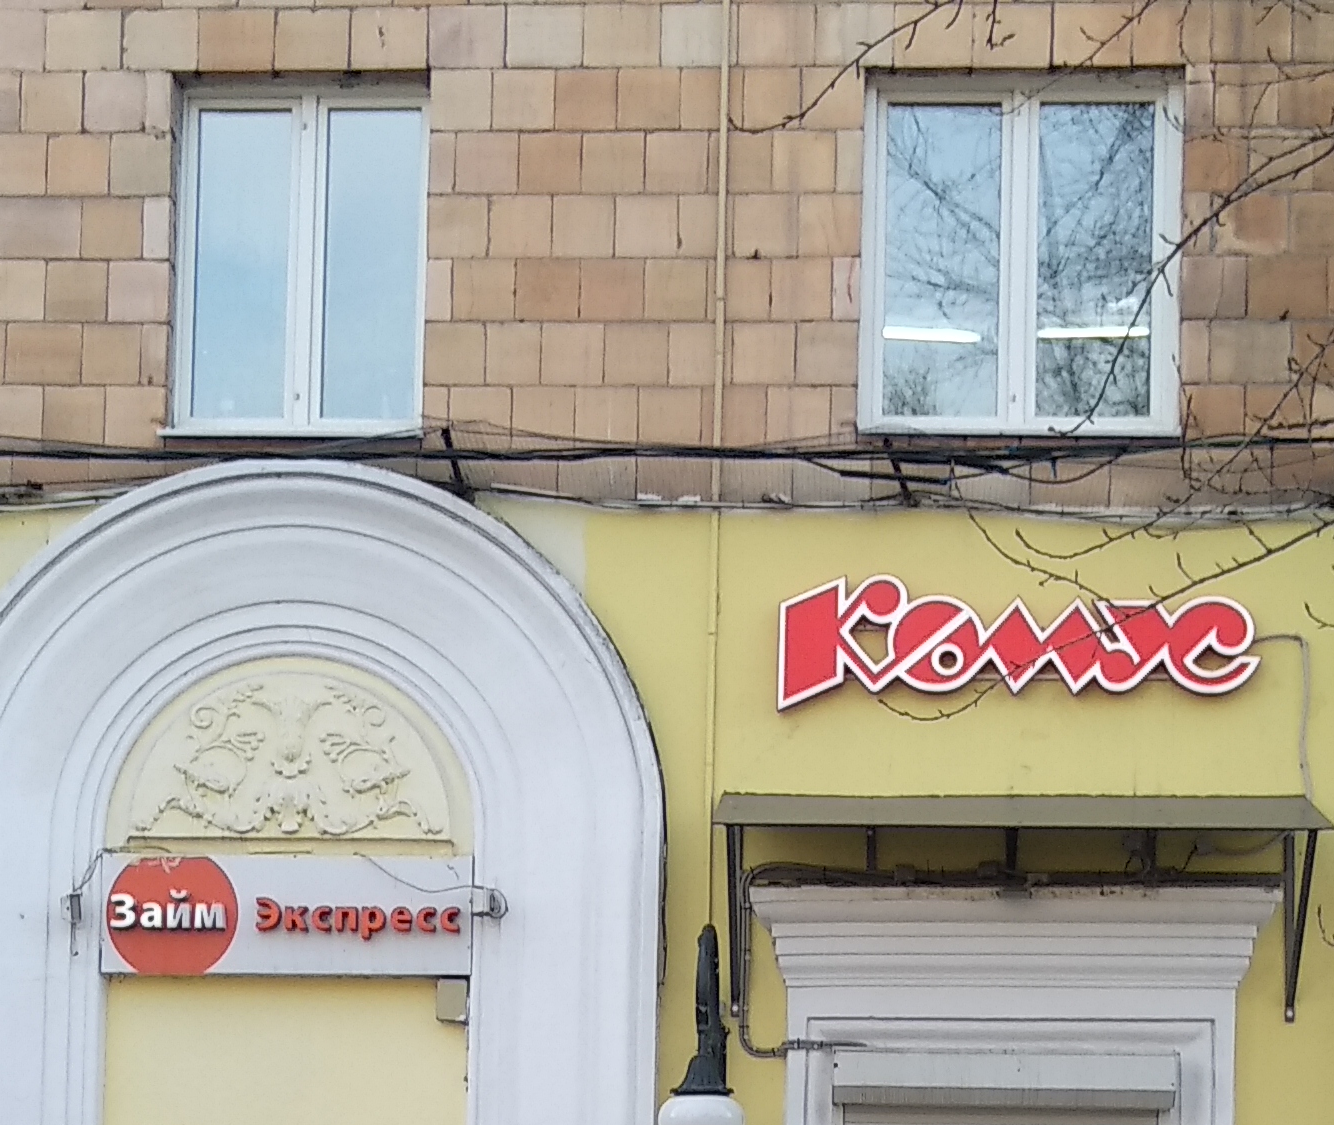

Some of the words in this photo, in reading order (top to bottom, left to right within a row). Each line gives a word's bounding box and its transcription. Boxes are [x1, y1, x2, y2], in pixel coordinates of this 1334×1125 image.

[777, 574, 1260, 711] Комус
[109, 888, 226, 931] Займ
[255, 896, 460, 941] Экспресс
